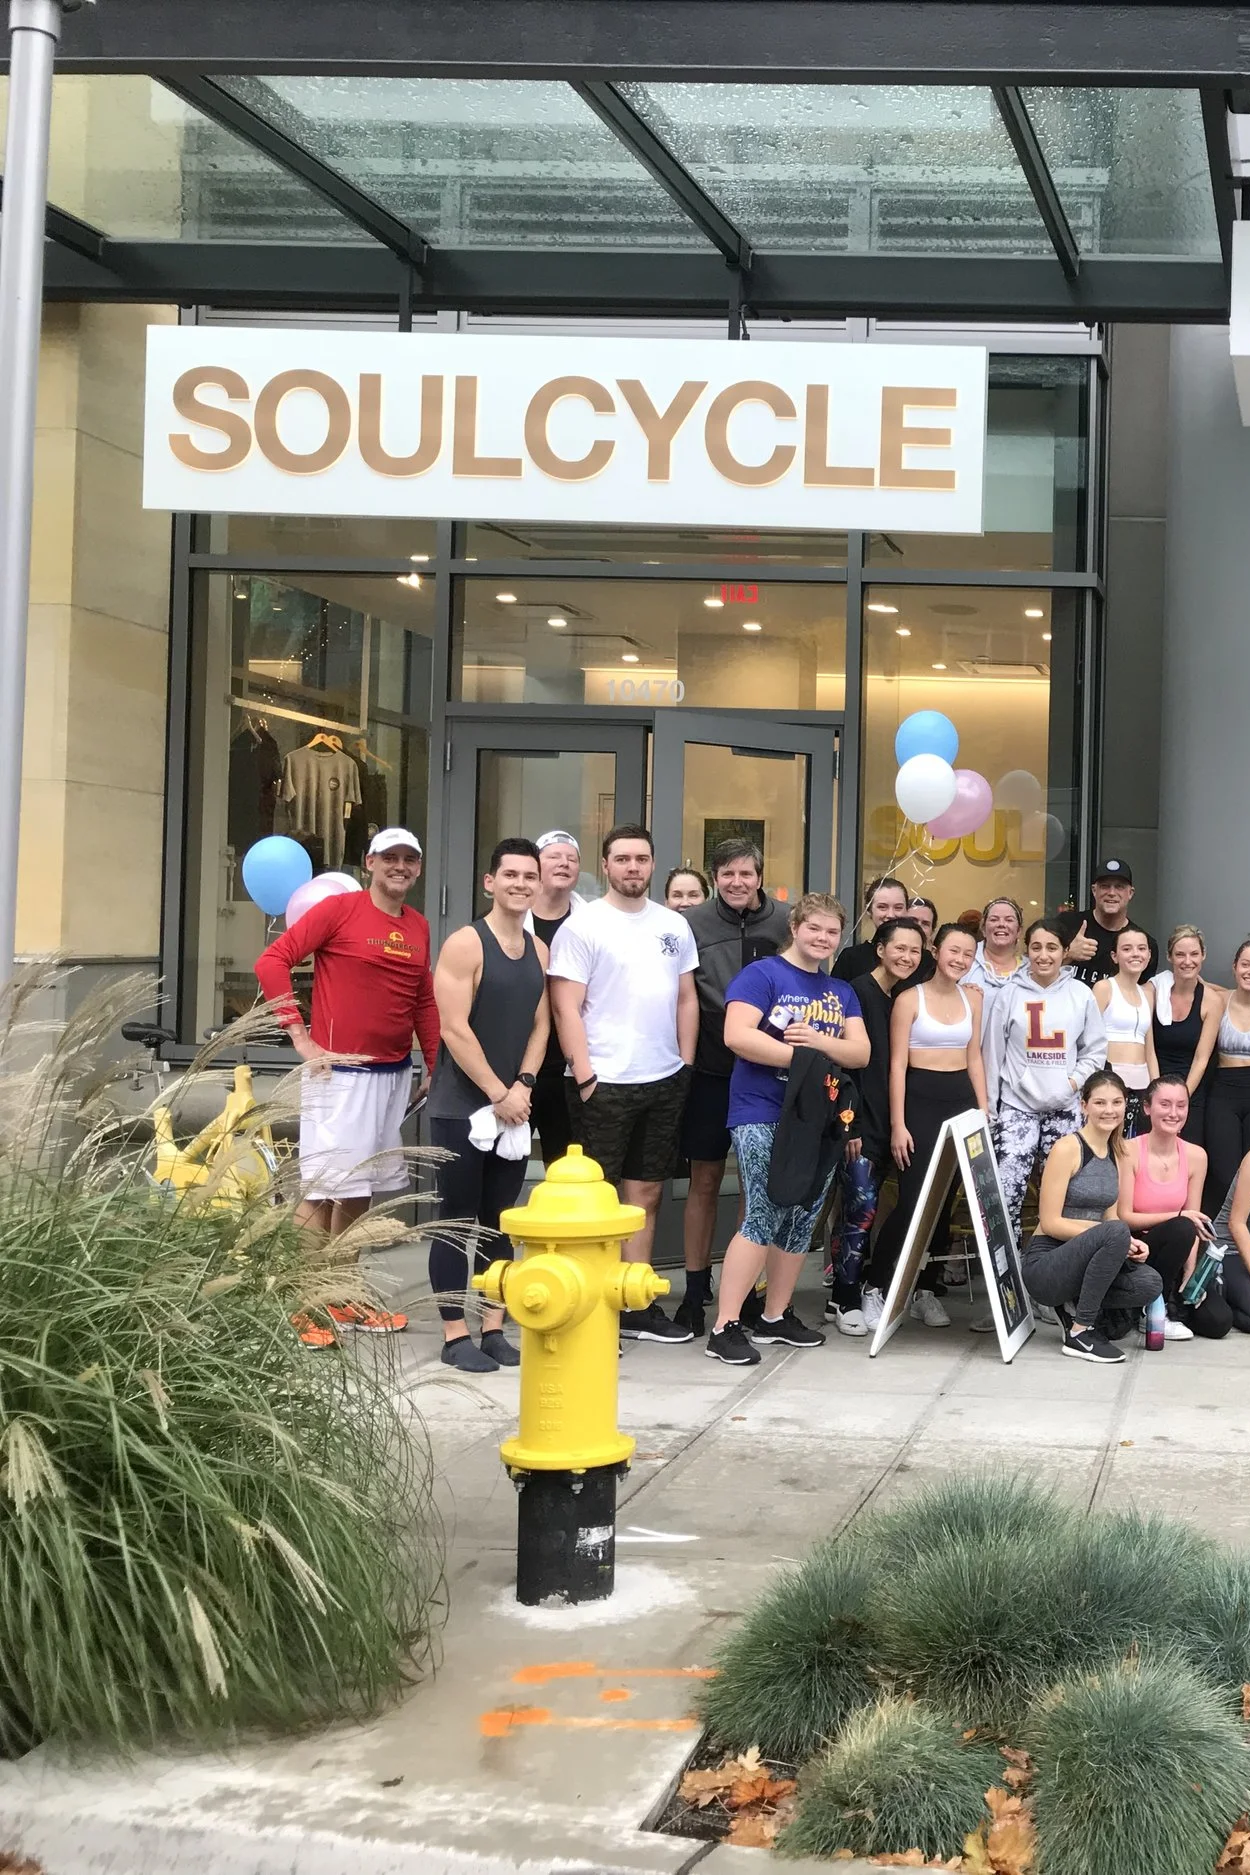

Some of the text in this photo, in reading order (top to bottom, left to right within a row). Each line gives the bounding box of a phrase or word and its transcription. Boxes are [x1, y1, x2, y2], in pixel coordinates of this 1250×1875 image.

[168, 364, 959, 491] SOULCYCLE
[606, 679, 686, 703] 10470
[777, 994, 810, 1004] Where
[812, 1022, 820, 1030] is
[1024, 1000, 1067, 1051] L
[1026, 1051, 1067, 1060] LAKESIDE
[539, 1383, 564, 1395] USA
